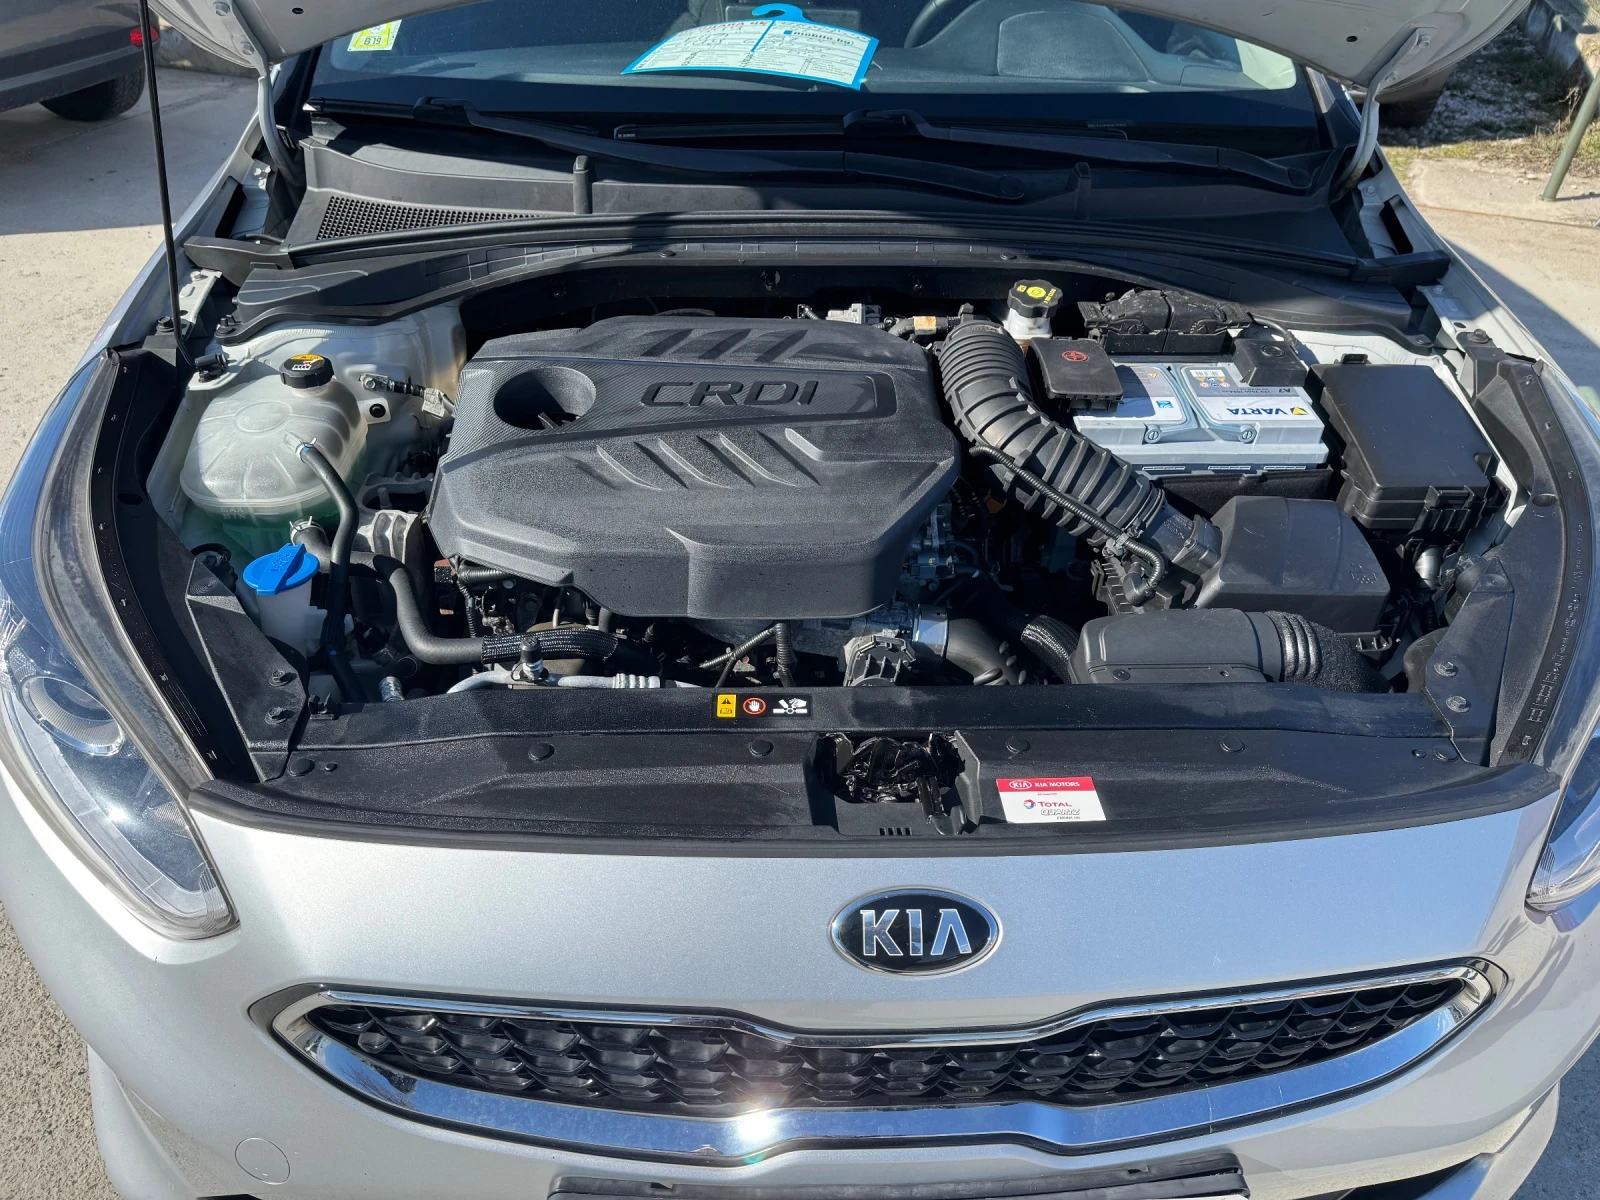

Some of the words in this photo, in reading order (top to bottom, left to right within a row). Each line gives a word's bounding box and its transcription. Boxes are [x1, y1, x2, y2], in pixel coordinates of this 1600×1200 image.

[640, 380, 819, 407] CRDI
[1040, 808, 1081, 816] QUARTZ
[859, 908, 973, 957] KIA
